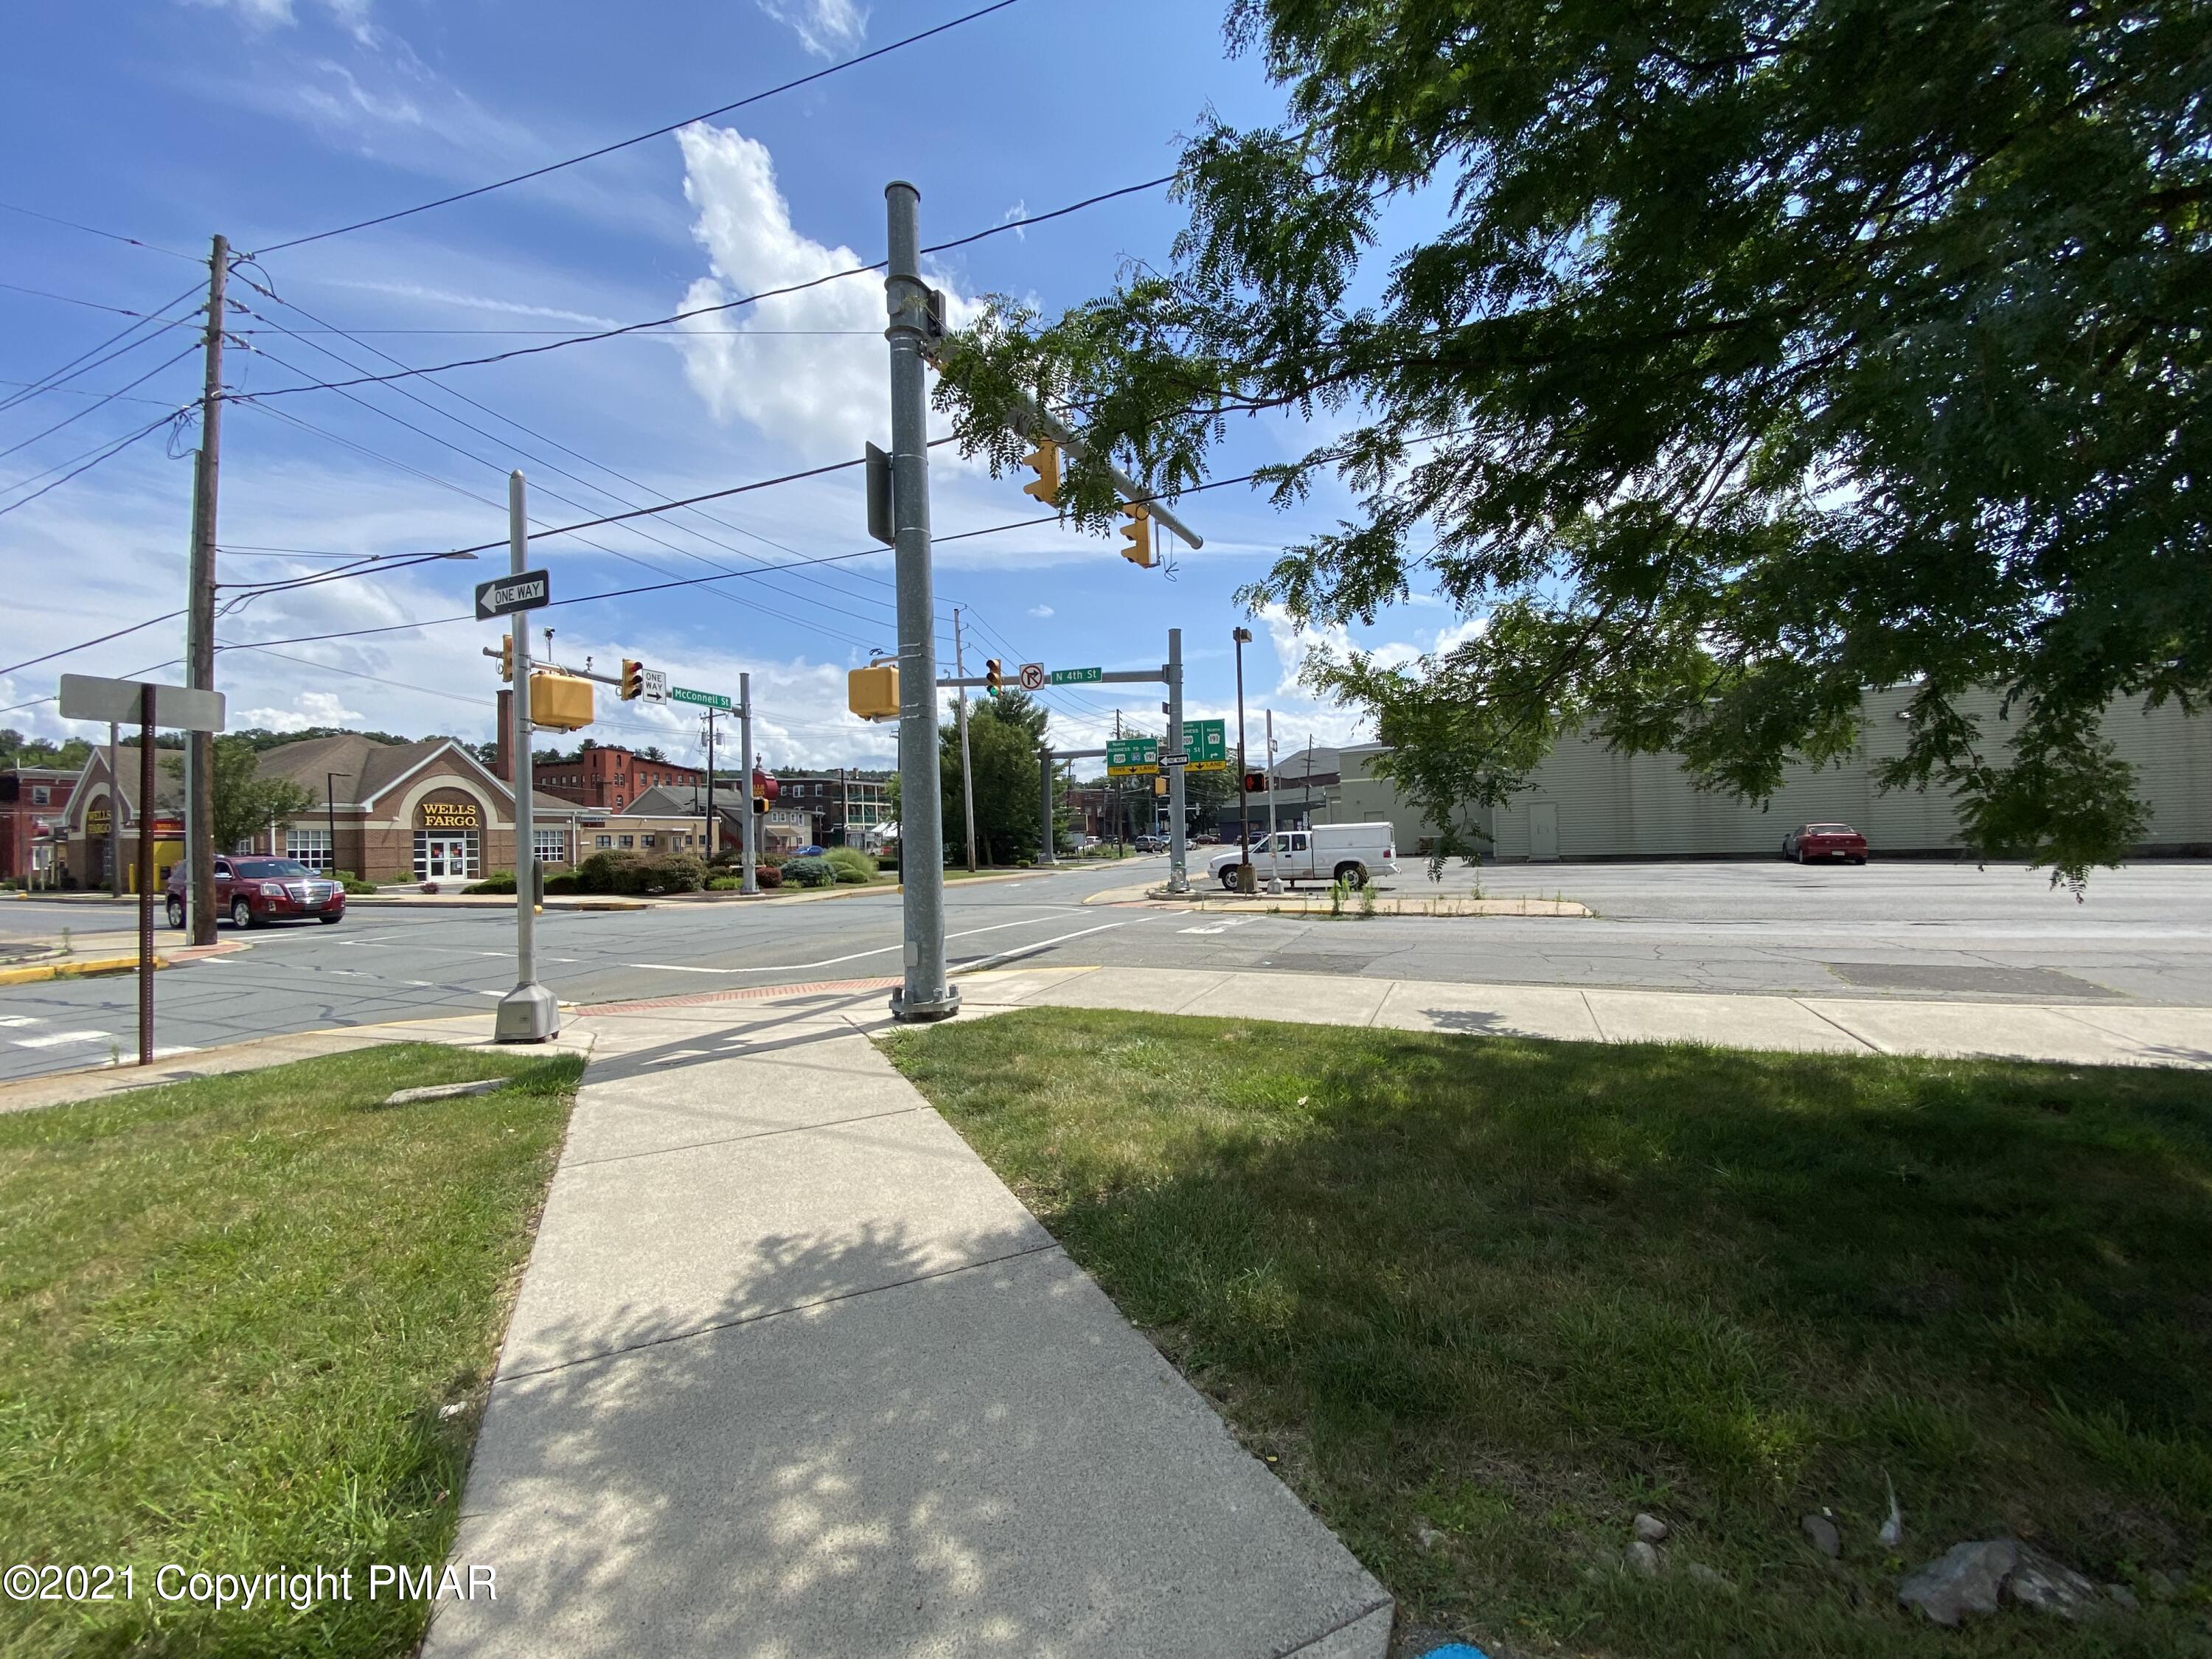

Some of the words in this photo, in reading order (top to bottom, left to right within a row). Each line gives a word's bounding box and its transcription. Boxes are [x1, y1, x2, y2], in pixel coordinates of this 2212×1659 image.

[495, 588, 515, 604] ONE
[517, 582, 540, 599] WAY
[646, 672, 661, 683] ONE
[1056, 672, 1062, 681] N
[1067, 670, 1082, 681] 4th
[1087, 669, 1096, 678] St
[646, 681, 663, 692] WAY
[675, 689, 718, 704] McConnell
[721, 697, 729, 706] St
[422, 804, 476, 815] WELLS
[425, 815, 476, 827] FARGO
